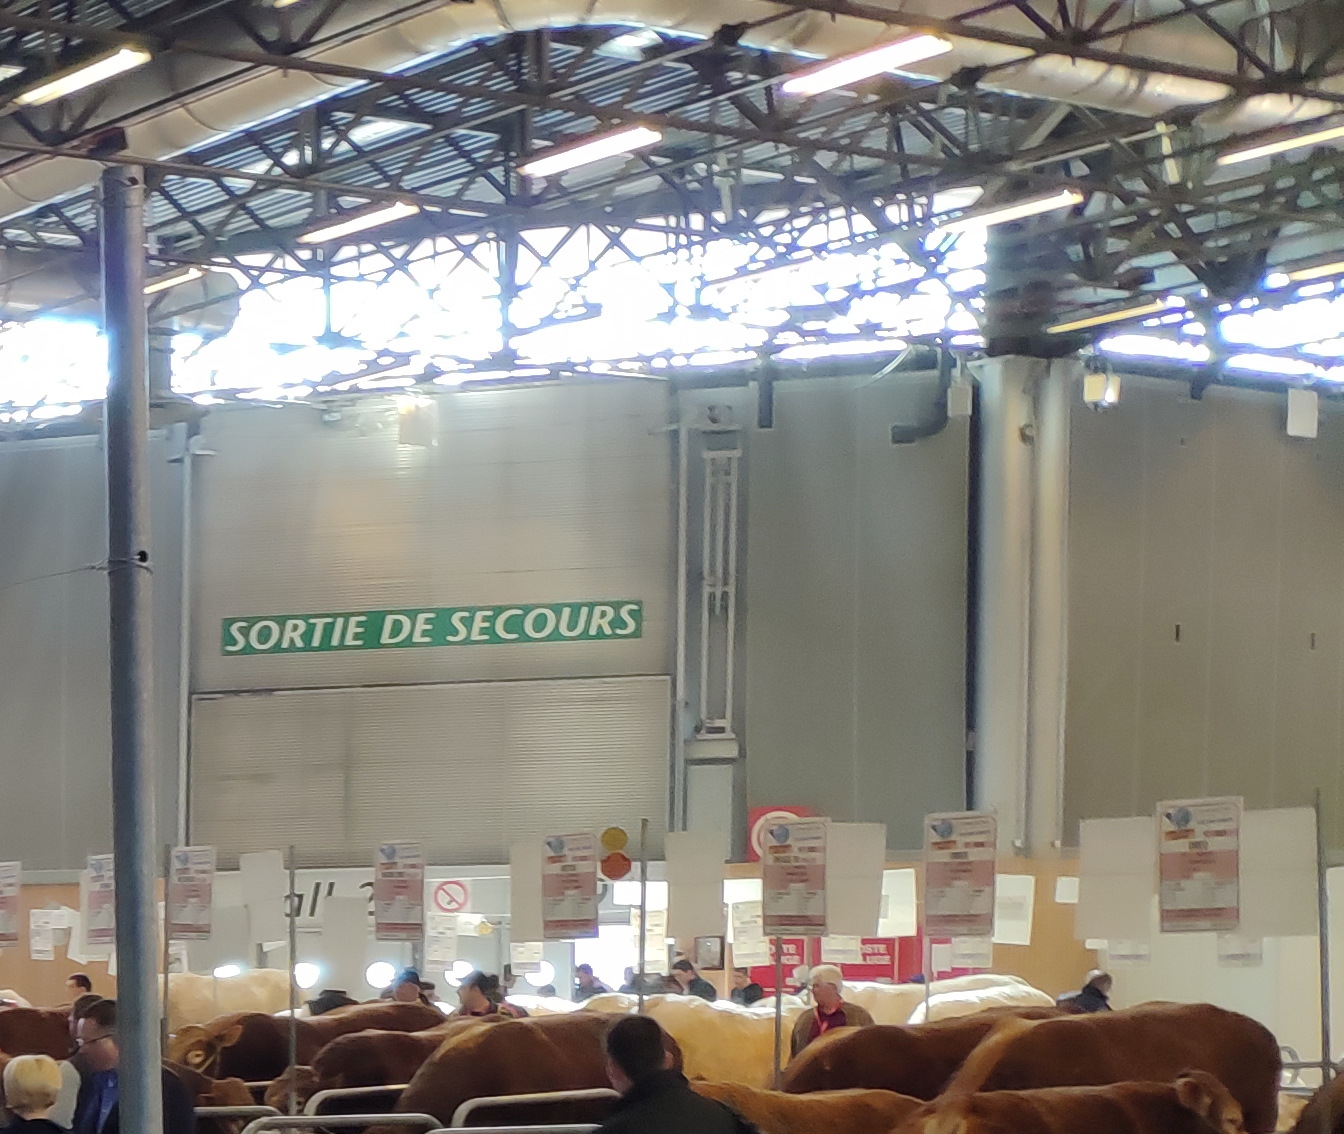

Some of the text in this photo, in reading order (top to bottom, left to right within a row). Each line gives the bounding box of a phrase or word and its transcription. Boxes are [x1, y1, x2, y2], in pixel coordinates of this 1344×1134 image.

[224, 603, 640, 651] SORTIE DE SECOURS
